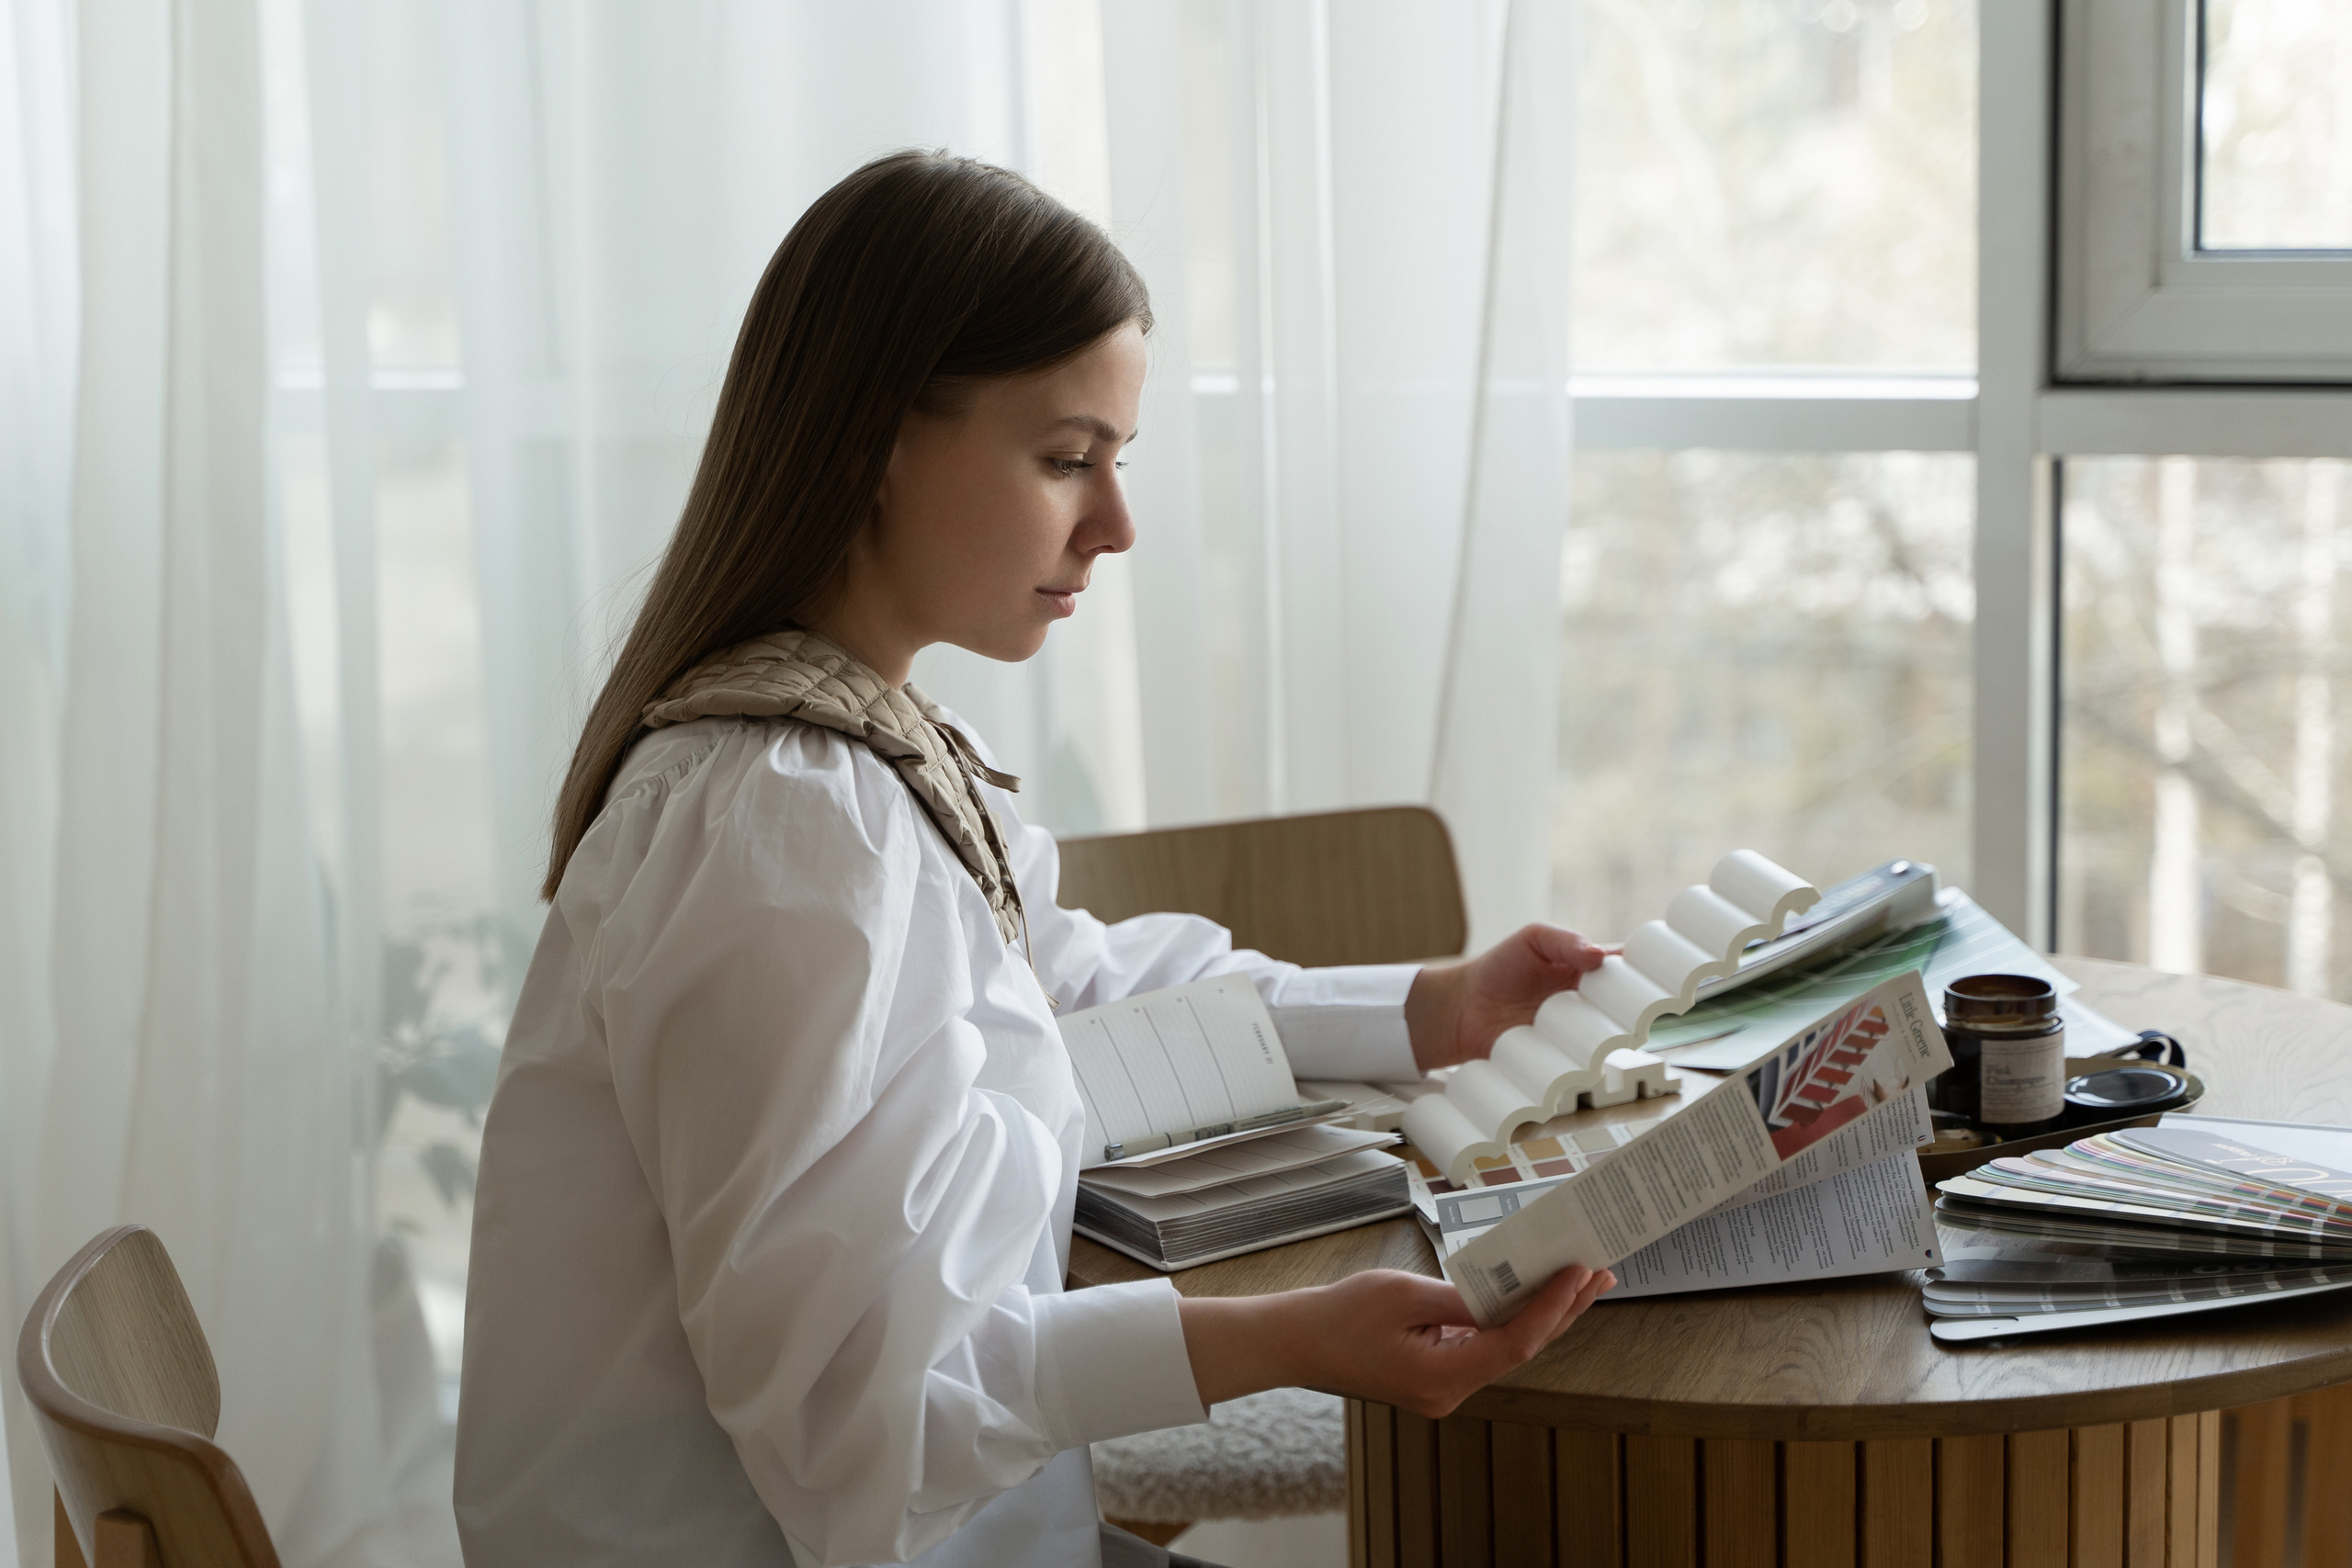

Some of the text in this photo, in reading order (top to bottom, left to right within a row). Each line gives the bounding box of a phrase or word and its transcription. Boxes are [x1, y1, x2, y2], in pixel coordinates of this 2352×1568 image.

[1251, 1021, 1270, 1055] FEBRUARY
[1899, 993, 1931, 1058] Little Greene
